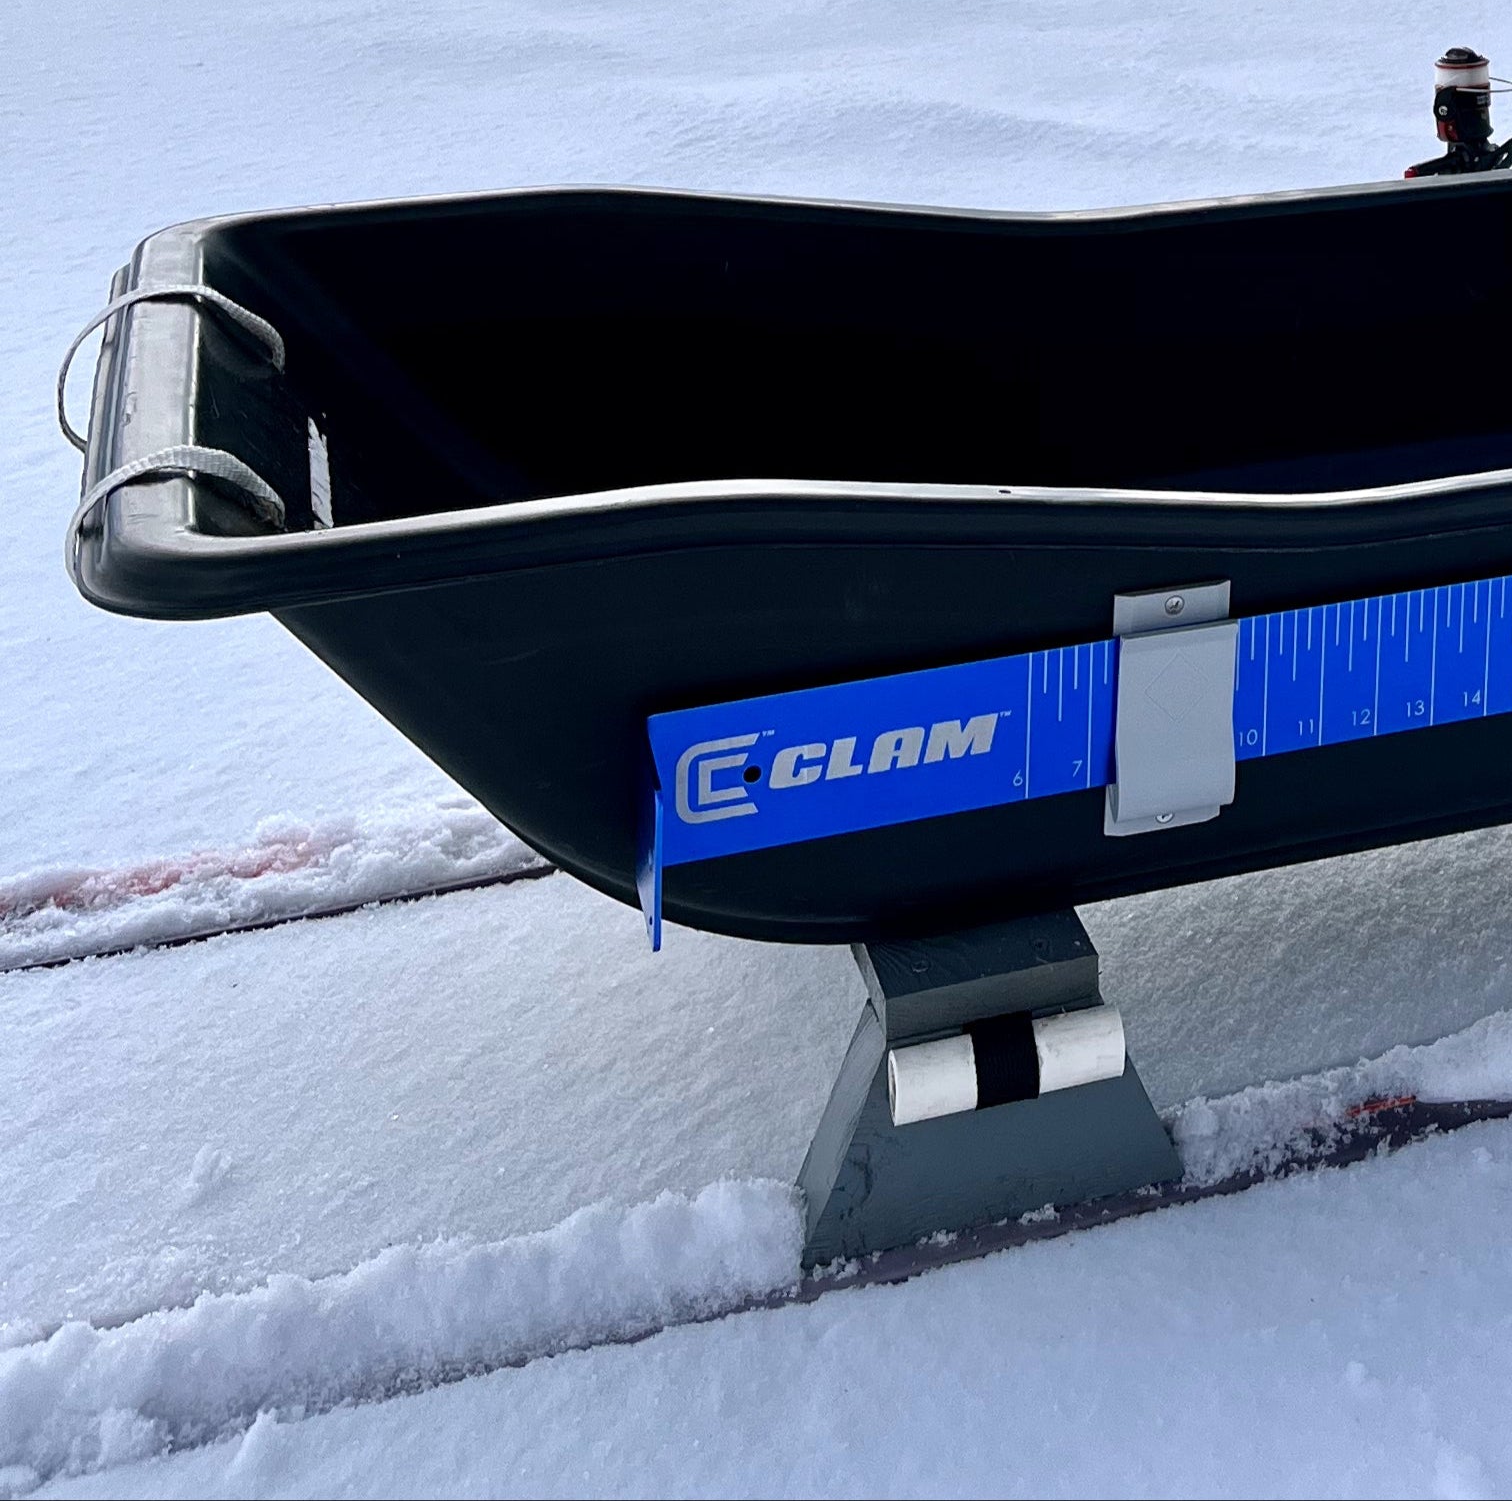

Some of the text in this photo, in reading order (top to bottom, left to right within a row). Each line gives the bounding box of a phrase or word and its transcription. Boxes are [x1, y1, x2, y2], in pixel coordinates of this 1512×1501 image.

[1013, 770, 1023, 786] 6
[1073, 760, 1082, 777] 7
[1240, 729, 1258, 746] 10
[1299, 719, 1313, 735] 11
[1352, 709, 1370, 726] 12
[1407, 700, 1424, 717] 13
[1464, 690, 1480, 706] 14
